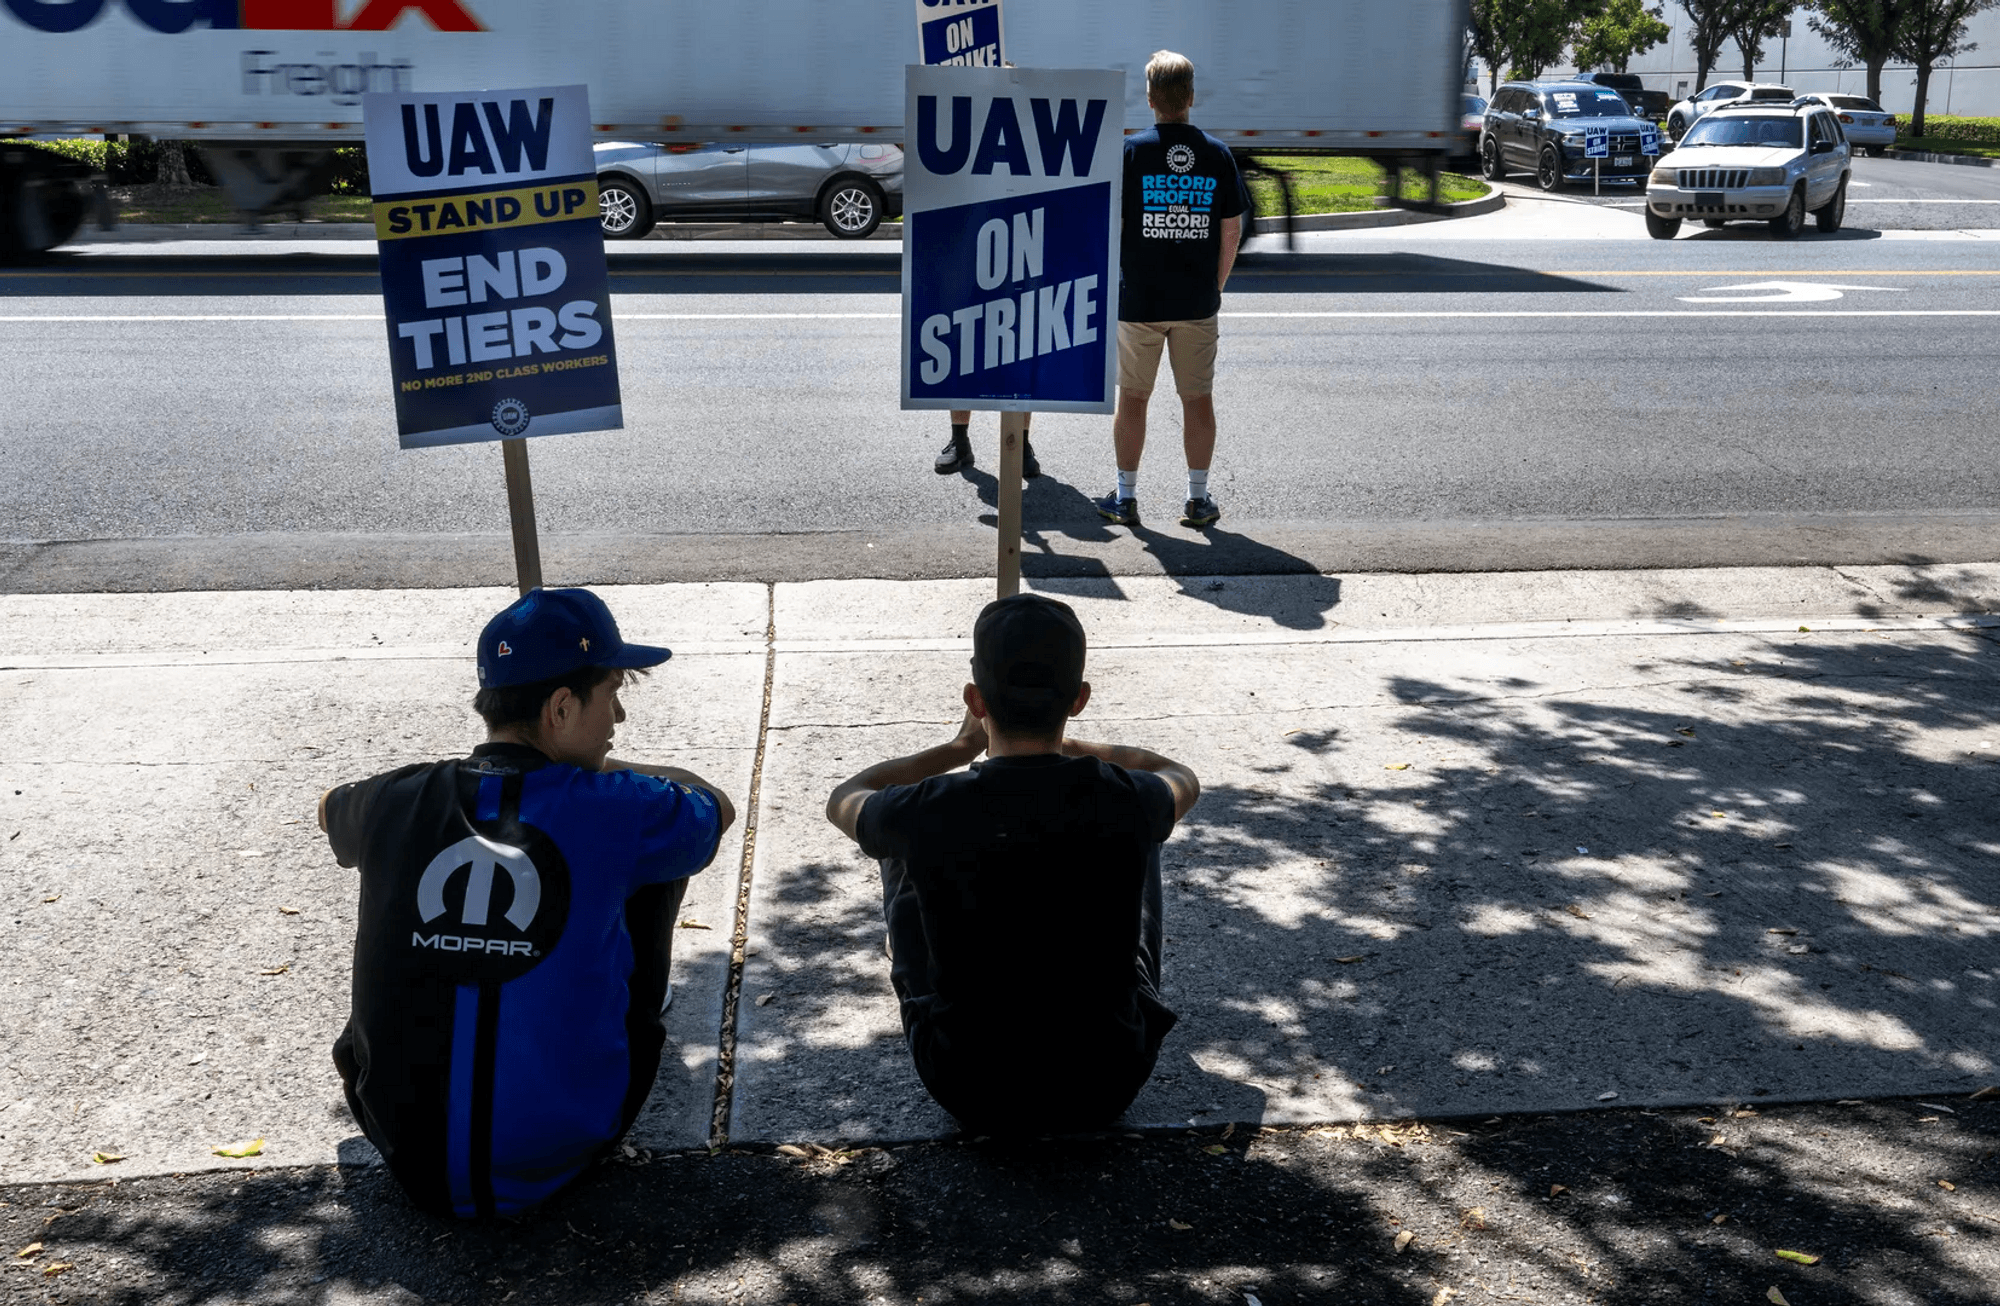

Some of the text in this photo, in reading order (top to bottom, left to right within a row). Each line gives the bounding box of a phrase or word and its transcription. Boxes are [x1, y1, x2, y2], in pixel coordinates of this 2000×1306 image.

[946, 17, 974, 53] ON
[401, 98, 554, 177] UAW
[916, 95, 1108, 177] UAW
[1587, 127, 1607, 135] UAW
[1142, 174, 1217, 191] RECORD
[1143, 190, 1214, 205] PROFITS
[388, 188, 586, 234] STAND UP
[1142, 213, 1210, 228] RECORD
[1168, 205, 1190, 213] EQUAL
[976, 207, 1045, 291] ON
[1142, 227, 1209, 239] CONTRACTS
[421, 247, 567, 308] END
[398, 300, 602, 370] TIERS
[920, 274, 1098, 385] STRIKE
[401, 355, 608, 392] NO MORE 2ND CLASS WORKERS
[412, 931, 532, 957] MOPAR
